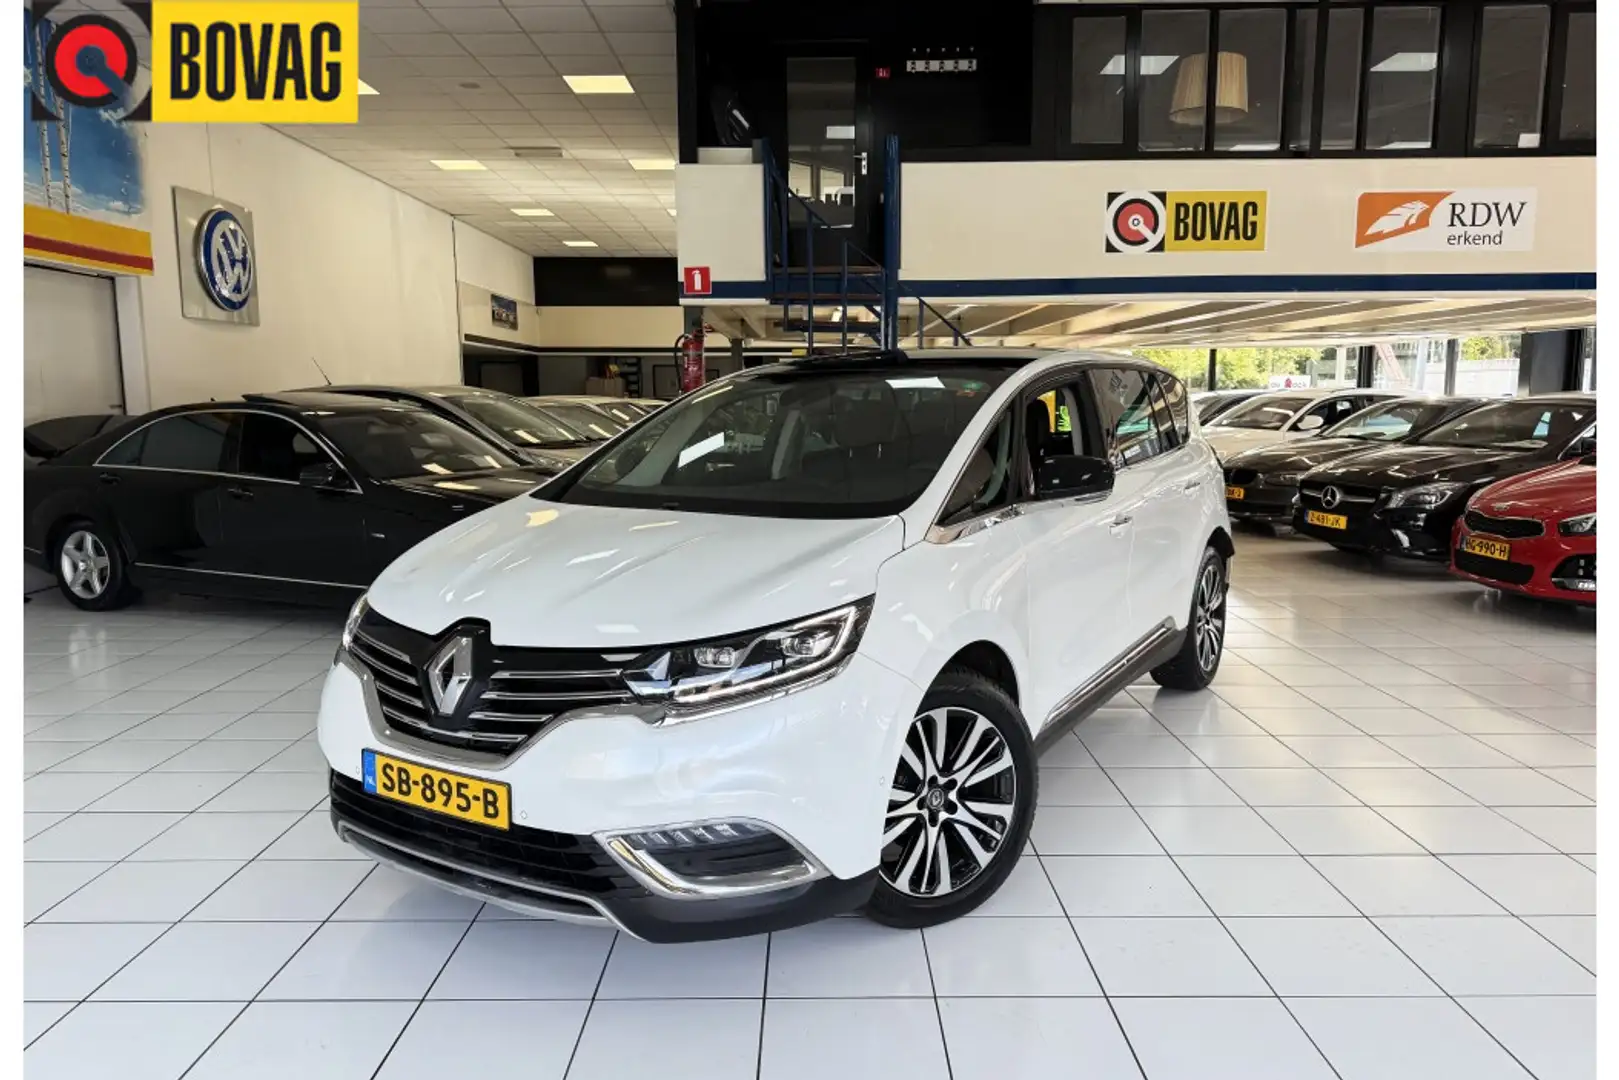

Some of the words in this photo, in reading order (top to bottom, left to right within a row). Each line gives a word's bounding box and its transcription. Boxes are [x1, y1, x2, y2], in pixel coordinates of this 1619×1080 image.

[1173, 201, 1259, 242] BOVAG
[1447, 201, 1528, 229] RDW
[1447, 231, 1504, 246] erkend
[381, 762, 500, 820] SB-895-B
